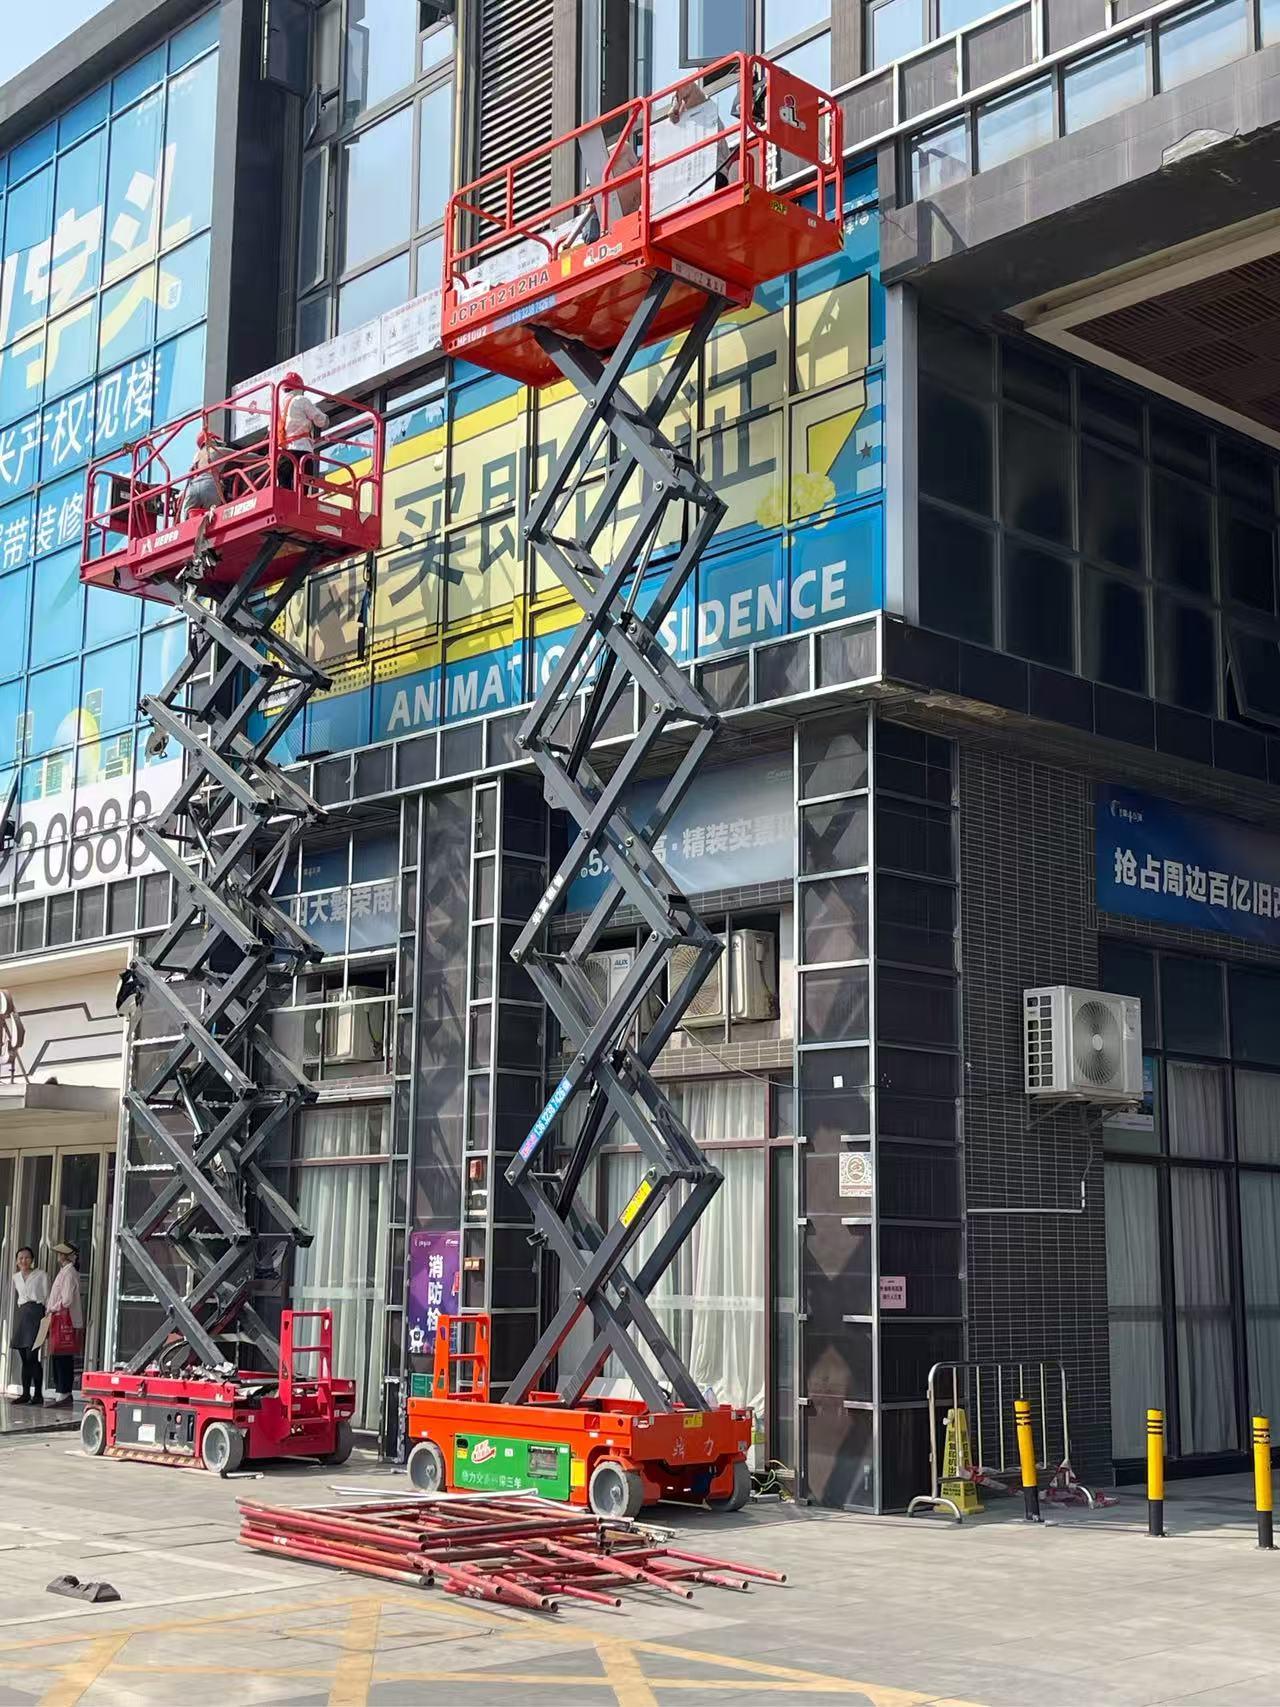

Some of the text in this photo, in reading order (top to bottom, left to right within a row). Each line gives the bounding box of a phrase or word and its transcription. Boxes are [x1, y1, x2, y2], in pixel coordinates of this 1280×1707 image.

[450, 269, 549, 326] JCPT1212HA
[0, 490, 84, 569] 带装修
[655, 560, 848, 660] SIDENCE
[0, 790, 152, 895] 20888
